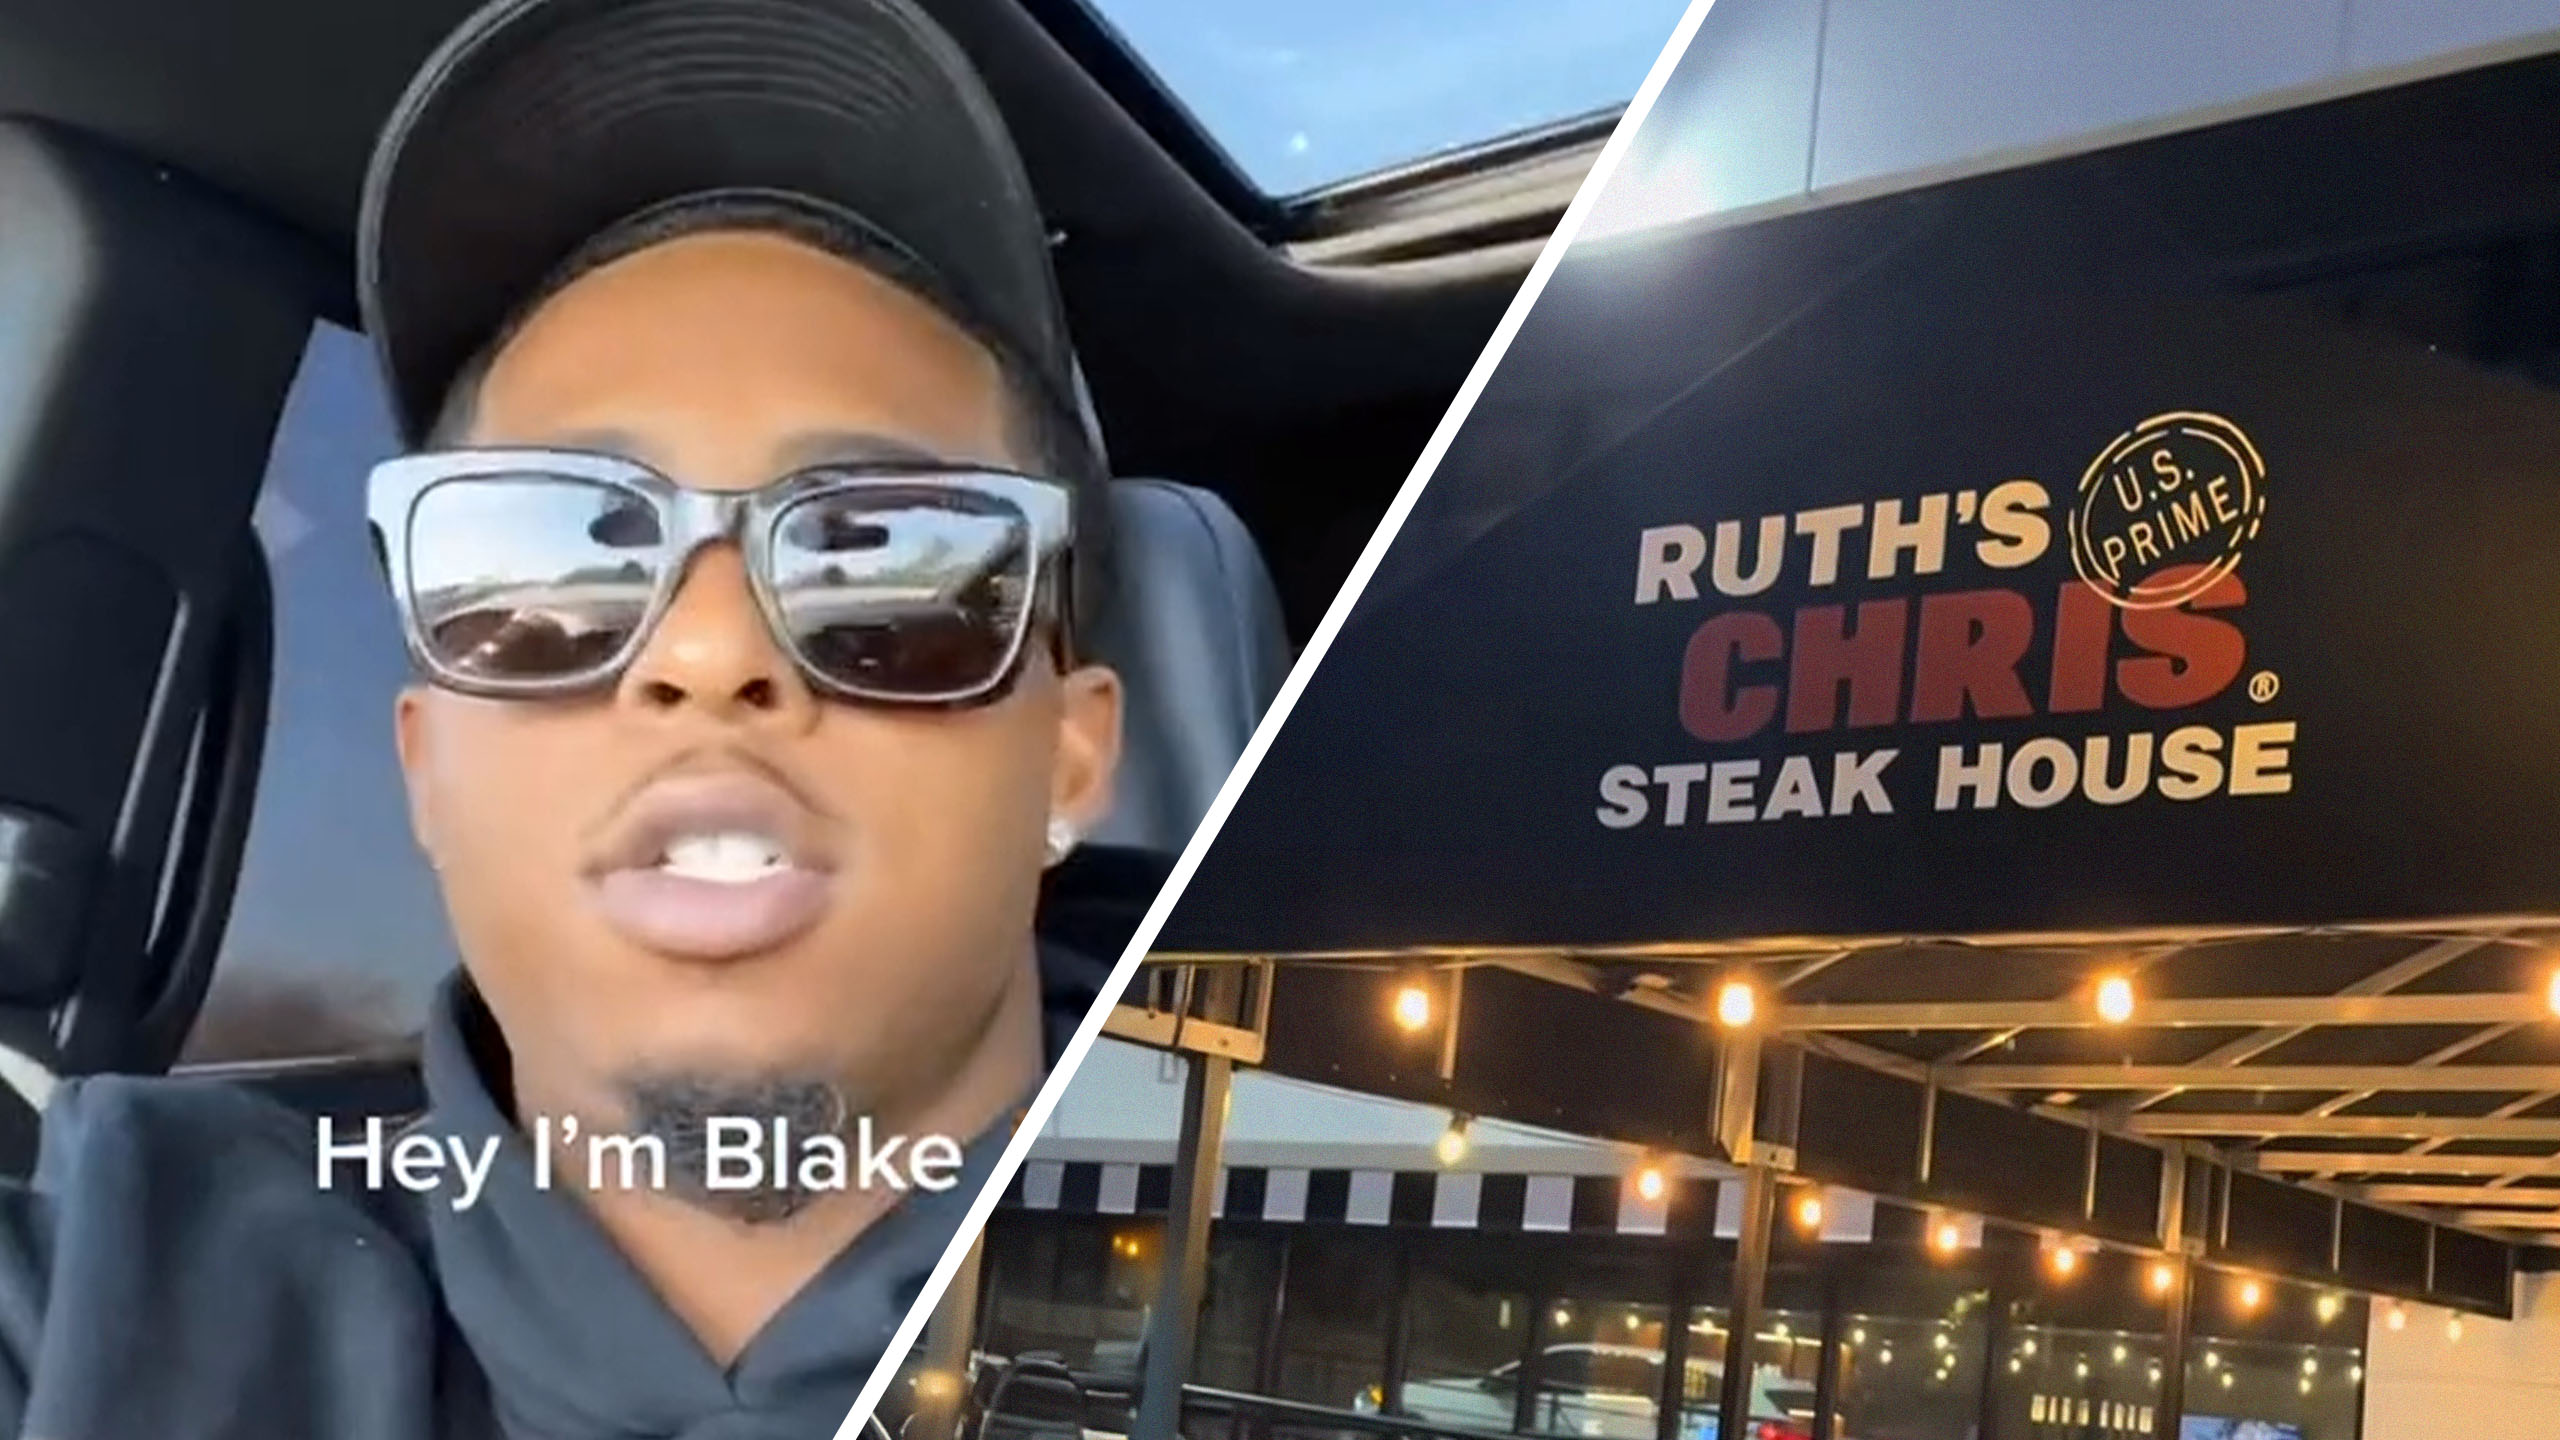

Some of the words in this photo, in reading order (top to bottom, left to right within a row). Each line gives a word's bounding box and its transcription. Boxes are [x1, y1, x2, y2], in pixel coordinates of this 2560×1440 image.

[2102, 474, 2239, 579] PRIME
[2113, 448, 2195, 514] U.S.
[1635, 480, 2051, 605] RUTH'S
[1677, 562, 2248, 743] CHRIS
[1596, 750, 1899, 828] STEAK
[1934, 722, 2298, 811] HOUSE
